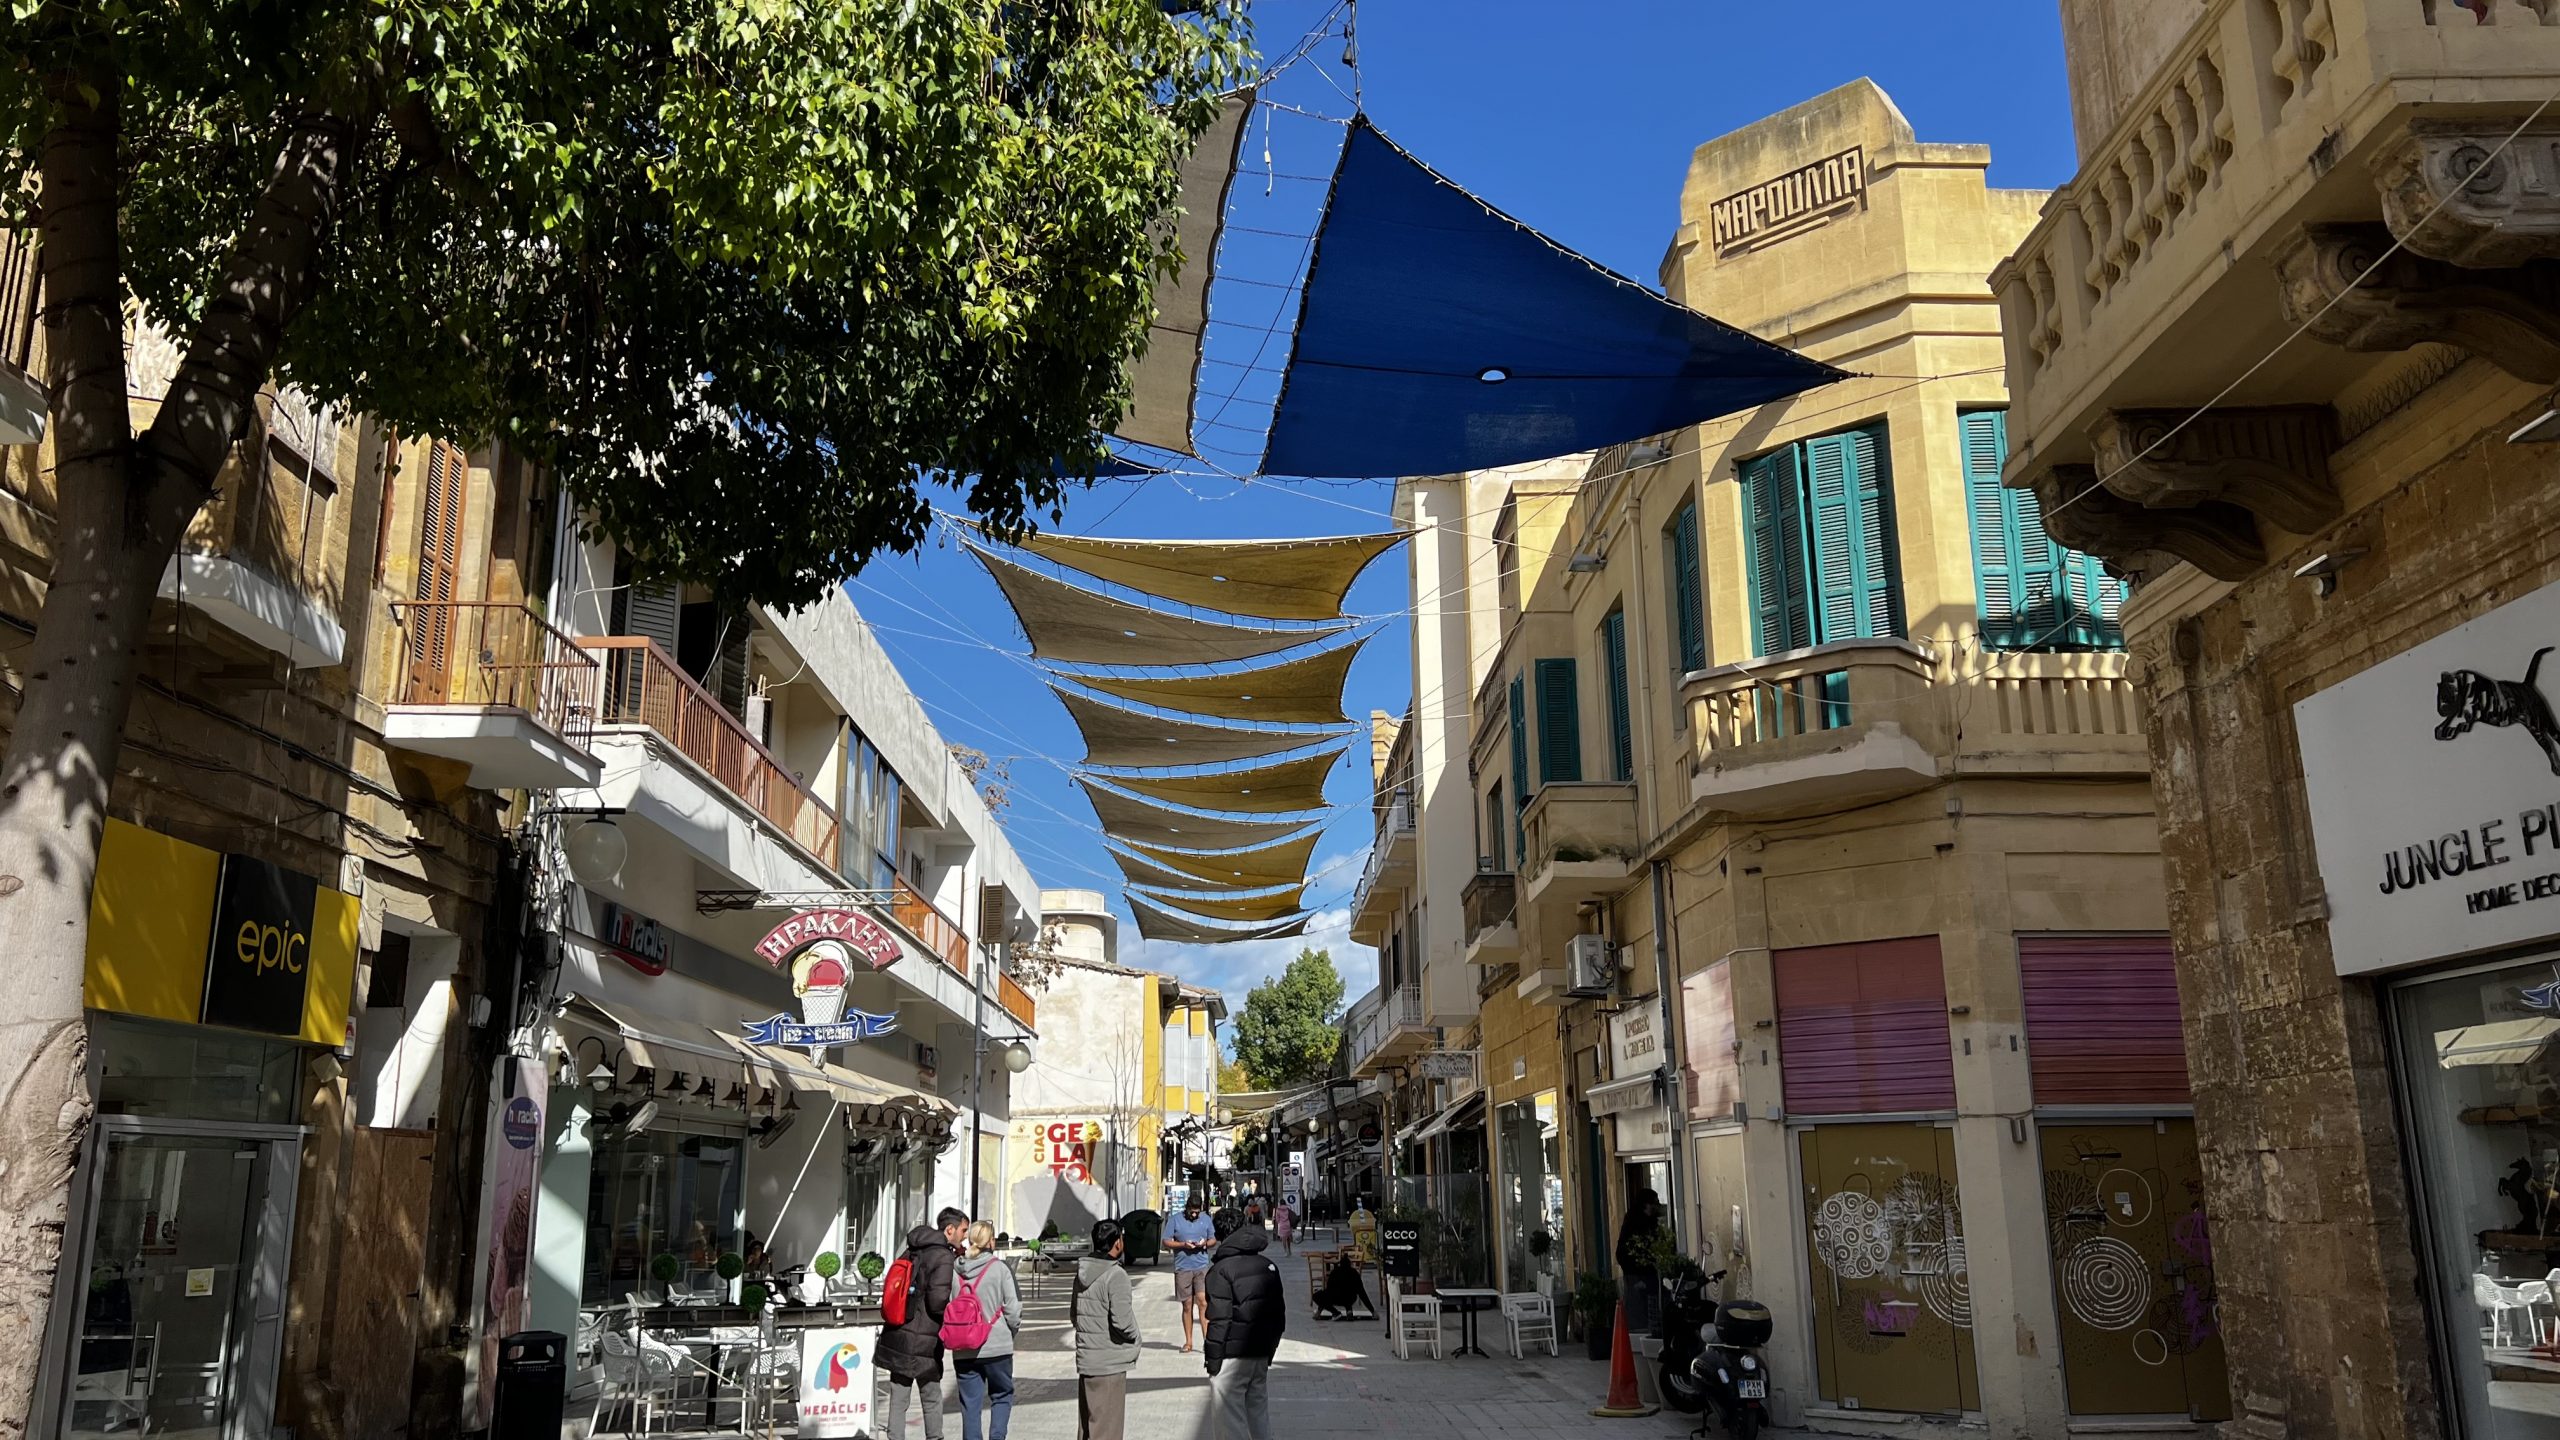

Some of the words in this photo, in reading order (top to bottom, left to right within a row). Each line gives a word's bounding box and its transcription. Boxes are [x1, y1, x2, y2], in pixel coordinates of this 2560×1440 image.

[2379, 819, 2510, 895] JUNGLE
[2466, 883, 2519, 915] HOME
[237, 920, 305, 977] epic
[1034, 1124, 1045, 1163] CIAO
[1047, 1123, 1084, 1143] GE
[1053, 1143, 1086, 1163] LA
[1384, 1230, 1417, 1240] ecco
